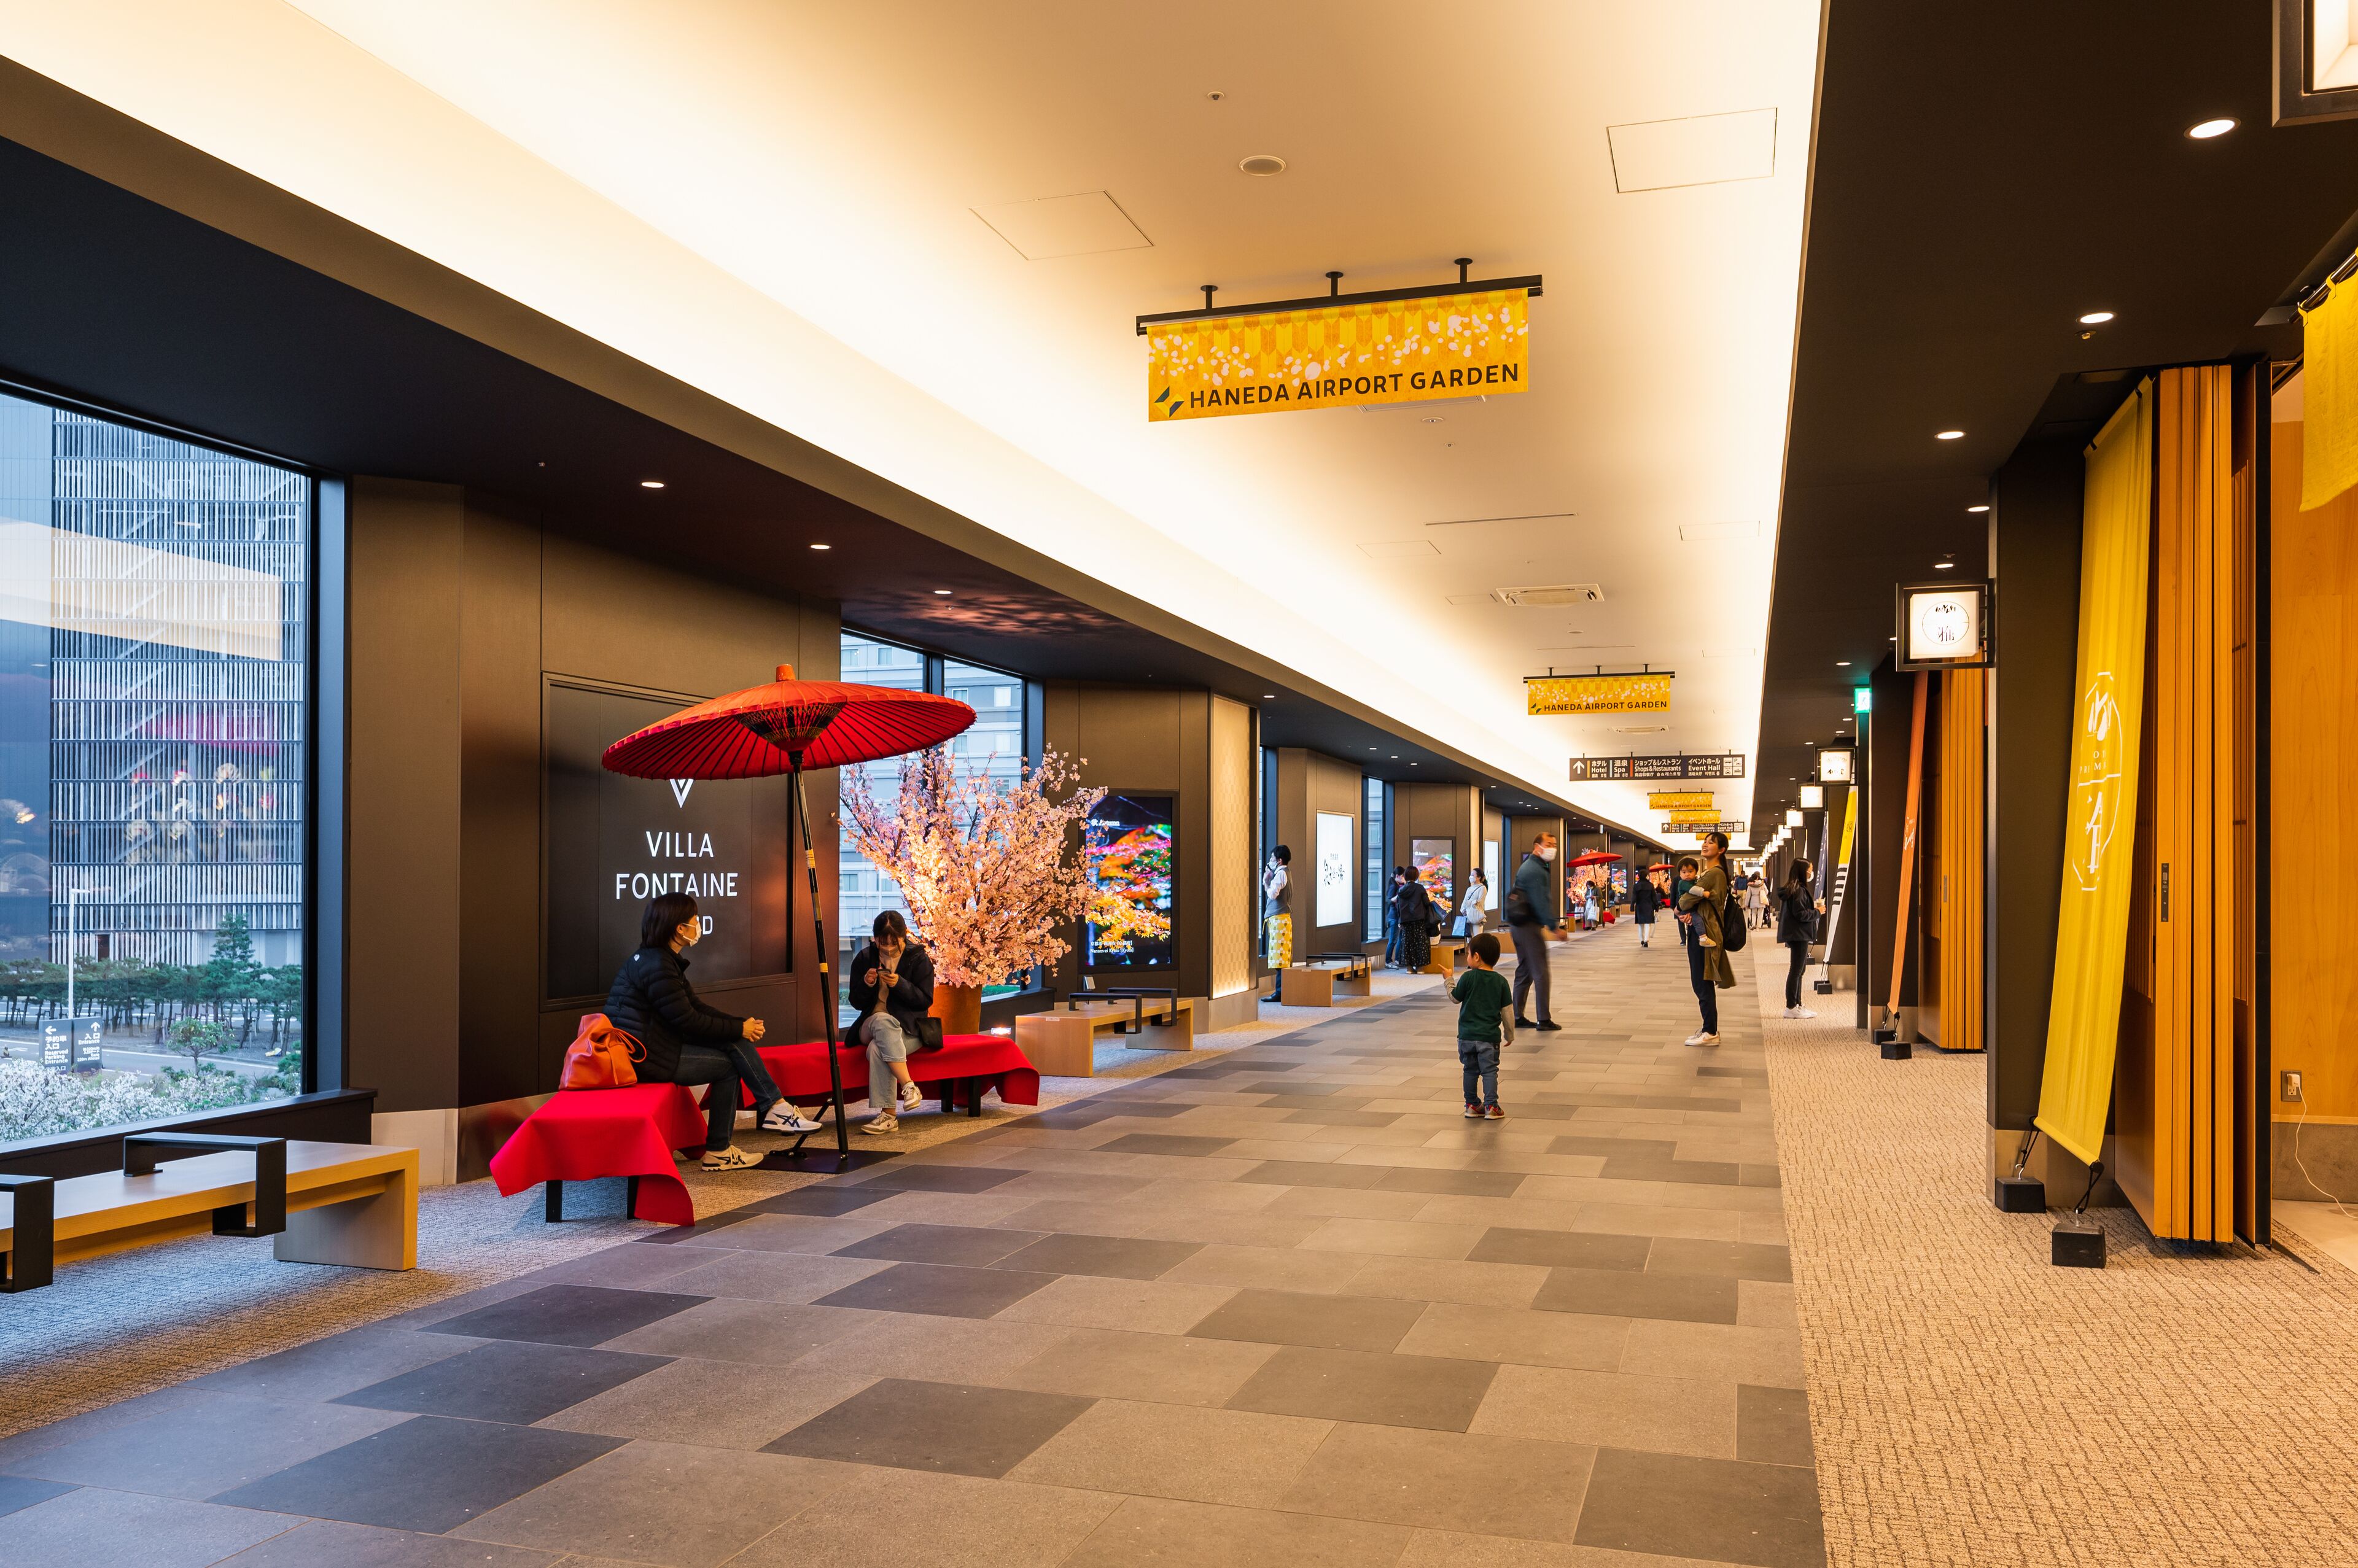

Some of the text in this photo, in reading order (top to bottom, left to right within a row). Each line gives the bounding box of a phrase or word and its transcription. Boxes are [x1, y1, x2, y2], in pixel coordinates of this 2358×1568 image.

[1190, 363, 1519, 408] HANEDA AIRPORT GARDEN
[1544, 703, 1582, 712] HANEDA
[1585, 702, 1624, 710] AIRPORT
[646, 831, 714, 857] VILLA
[616, 872, 738, 899] FONTAINE
